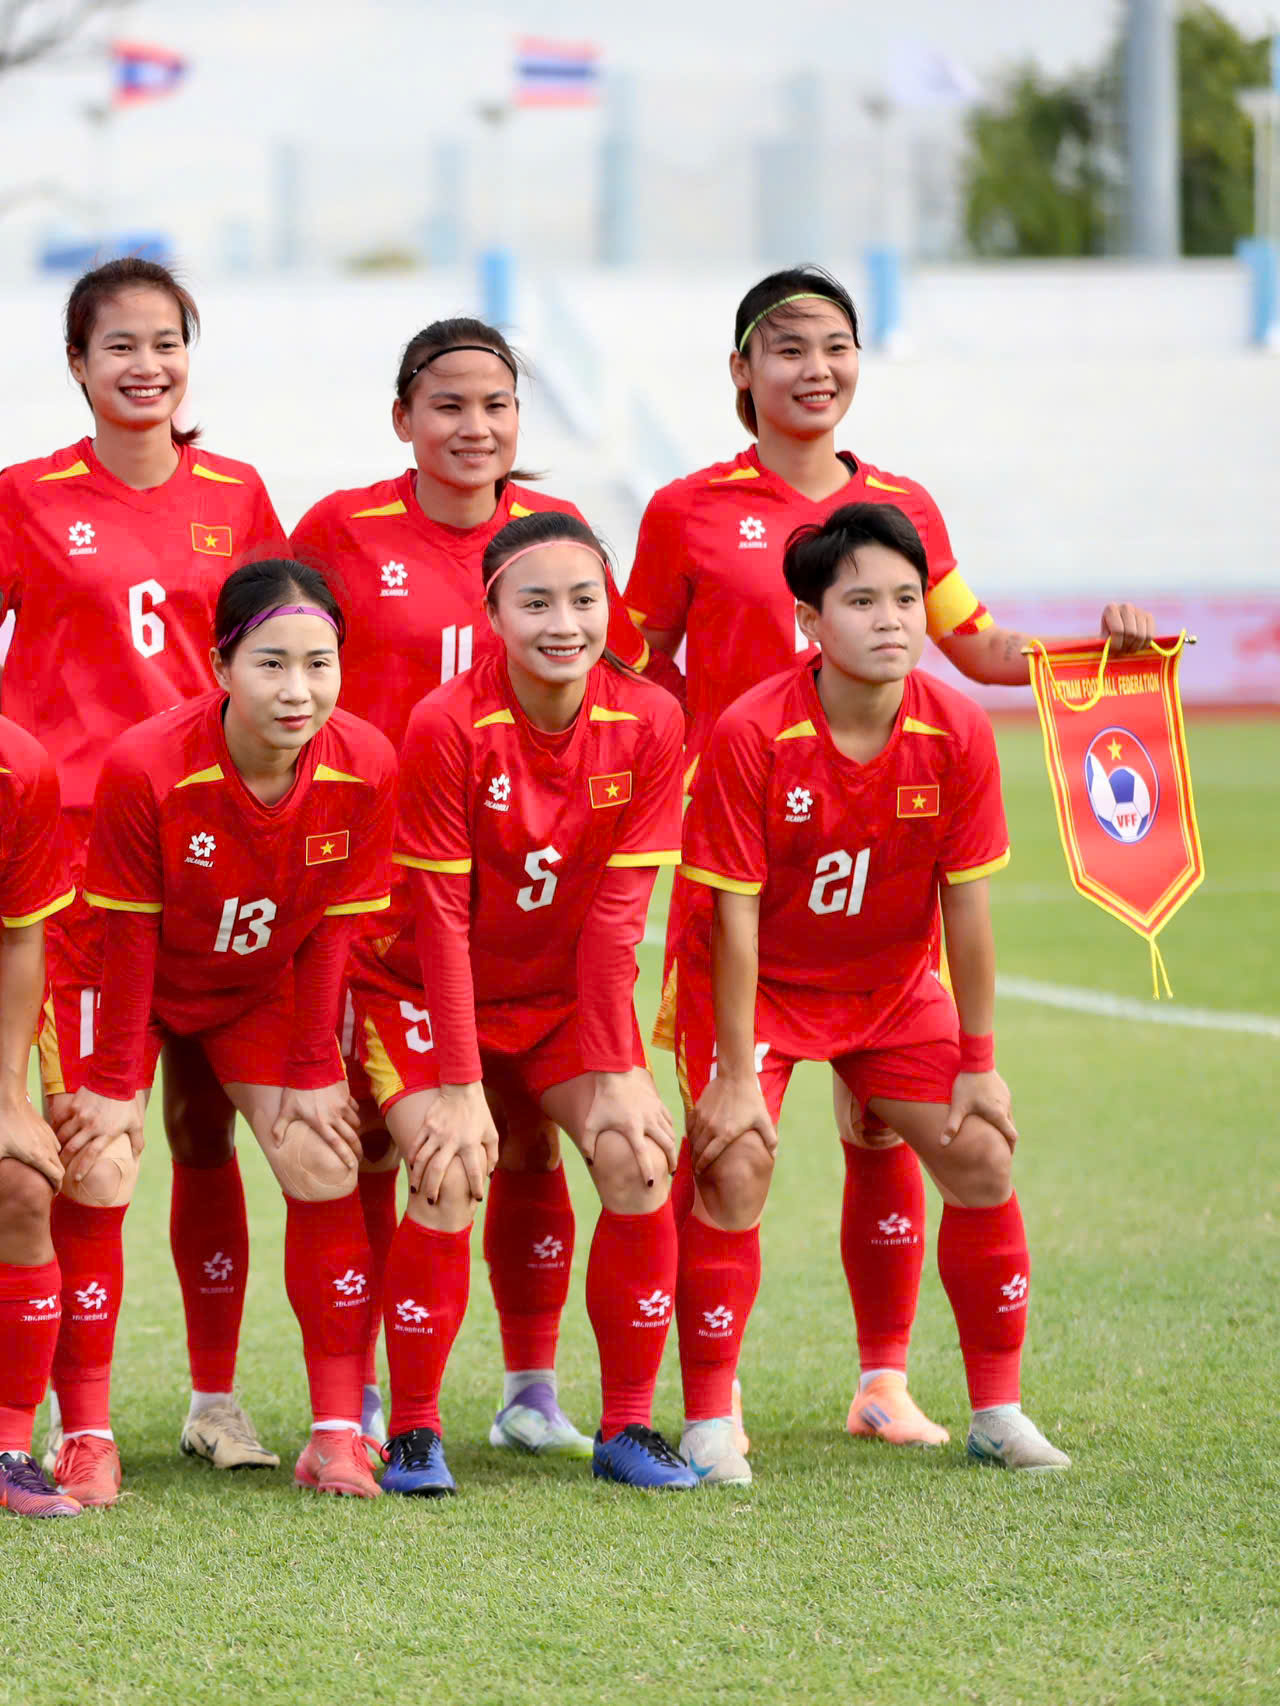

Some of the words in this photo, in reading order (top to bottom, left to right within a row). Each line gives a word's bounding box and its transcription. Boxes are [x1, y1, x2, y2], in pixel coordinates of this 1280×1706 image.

[129, 579, 166, 658] 6
[441, 624, 473, 685] 11
[1119, 671, 1160, 695] FEDERATION
[1116, 813, 1137, 827] VFF
[516, 845, 562, 912] 5
[808, 848, 871, 917] 21
[213, 896, 277, 956] 13
[399, 1000, 434, 1054] 5
